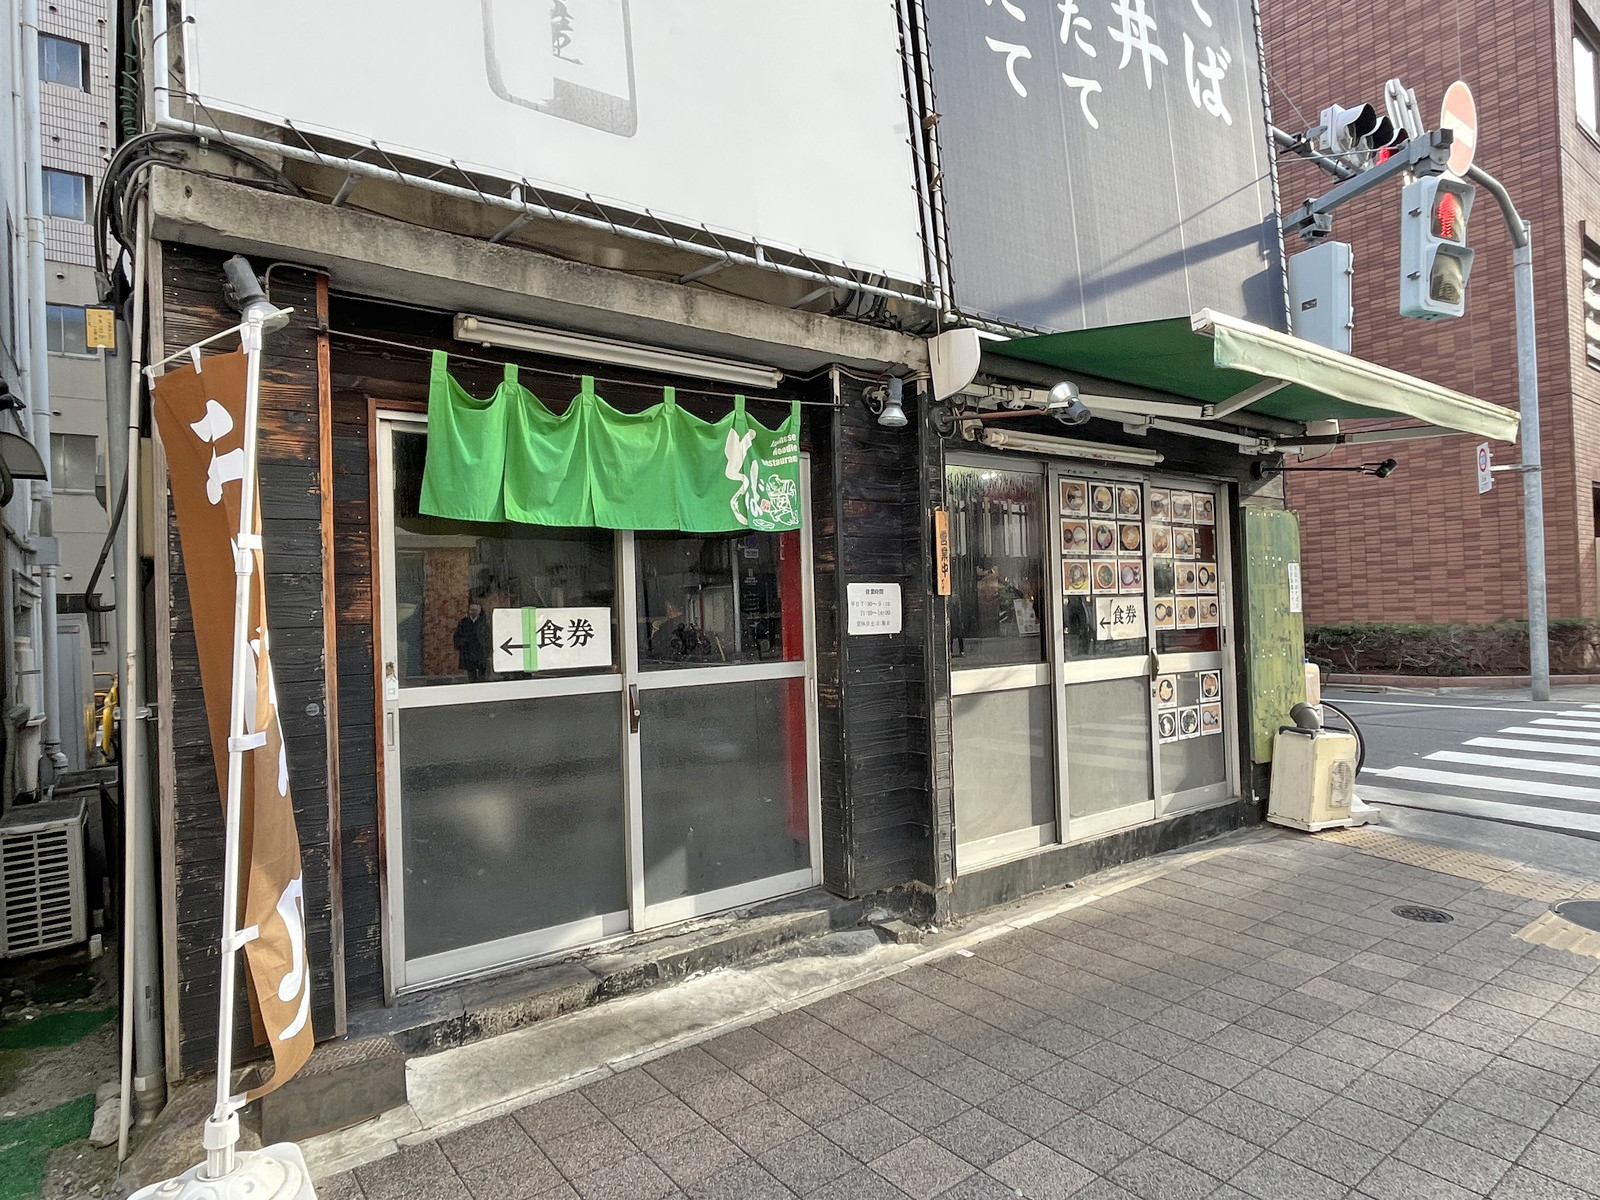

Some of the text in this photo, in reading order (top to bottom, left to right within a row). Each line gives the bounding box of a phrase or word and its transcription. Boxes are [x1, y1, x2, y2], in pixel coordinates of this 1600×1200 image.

[1057, 0, 1102, 130] たて
[1112, 604, 1137, 626] 食券
[535, 618, 595, 649] 食券
